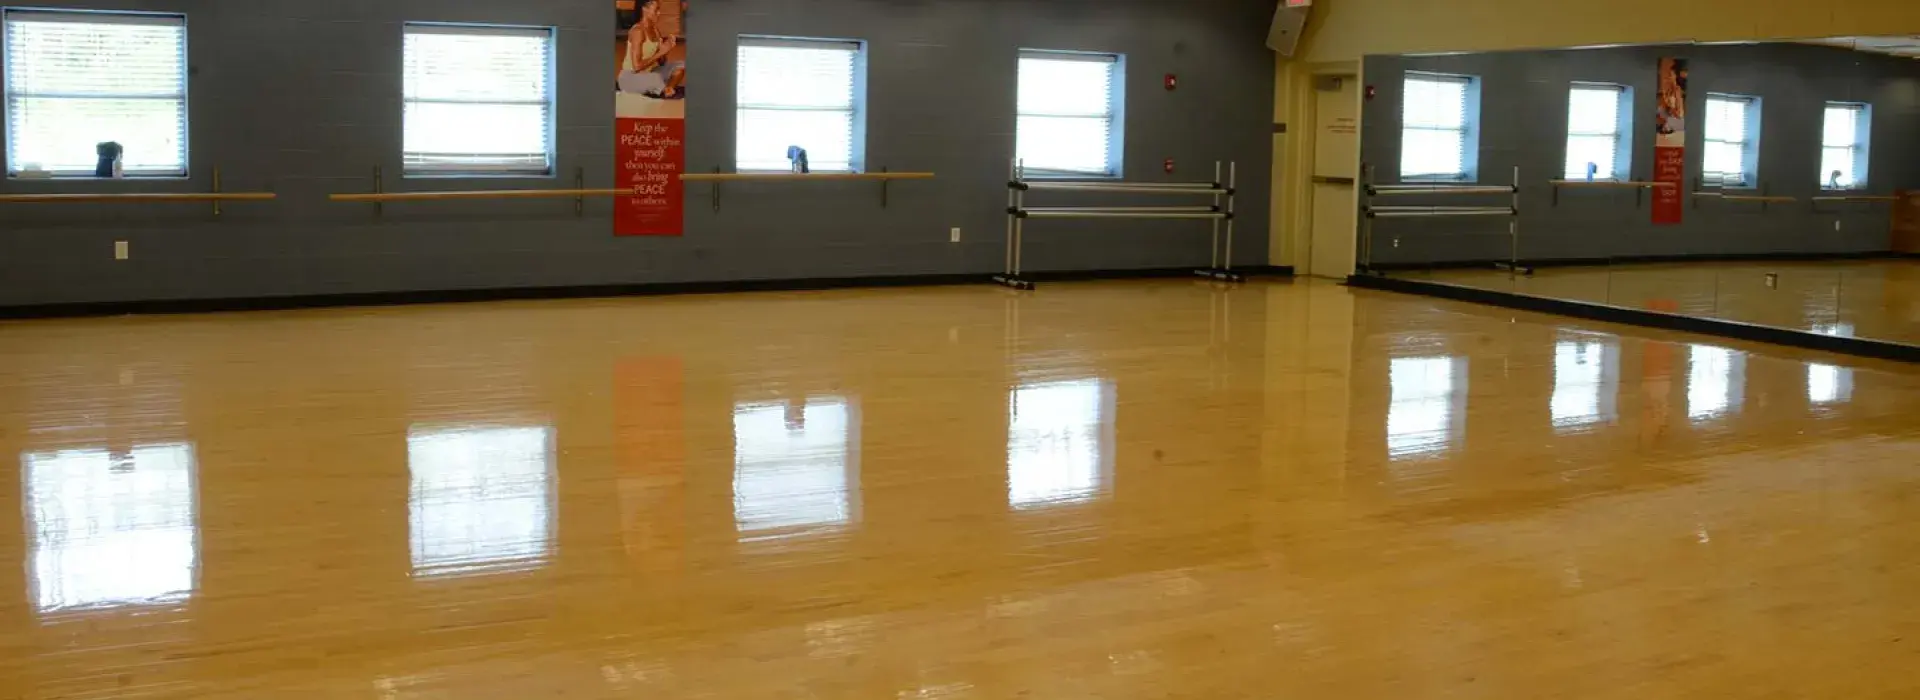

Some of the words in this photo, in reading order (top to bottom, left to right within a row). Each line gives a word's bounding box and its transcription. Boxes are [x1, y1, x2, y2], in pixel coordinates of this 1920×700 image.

[634, 121, 653, 135] Keep
[620, 134, 652, 146] PEACE
[648, 170, 669, 186] bring
[634, 184, 666, 195] PEACE
